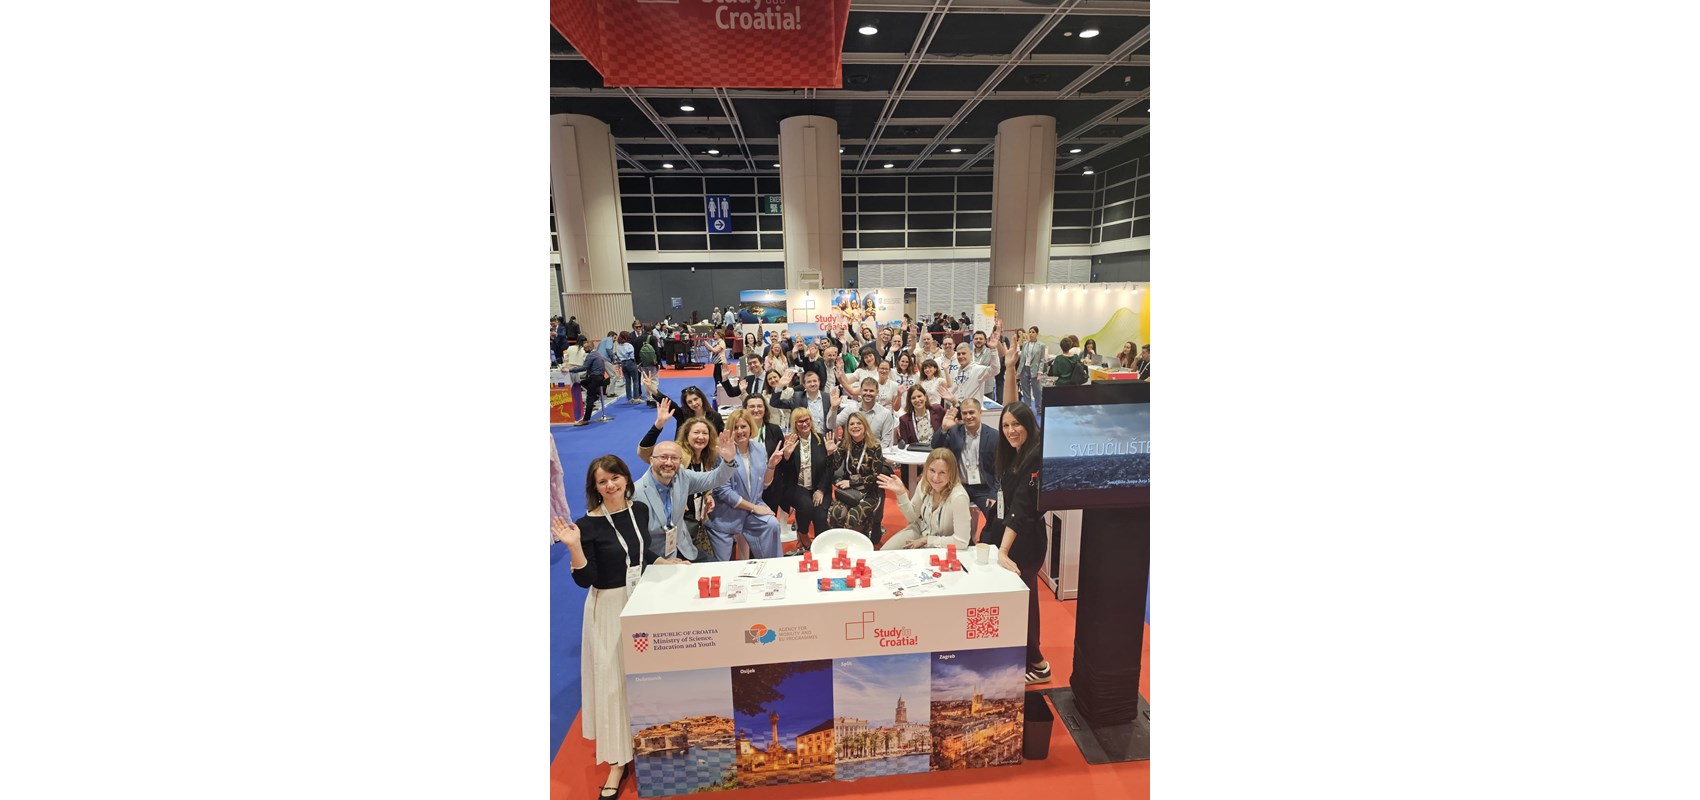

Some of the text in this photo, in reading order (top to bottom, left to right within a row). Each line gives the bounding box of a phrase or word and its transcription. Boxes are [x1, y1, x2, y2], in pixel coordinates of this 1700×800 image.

[715, 5, 801, 30] Croatia!
[815, 314, 837, 324] Study
[874, 627, 902, 639] Study
[653, 643, 684, 651] Education
[880, 636, 918, 648] Croatia!
